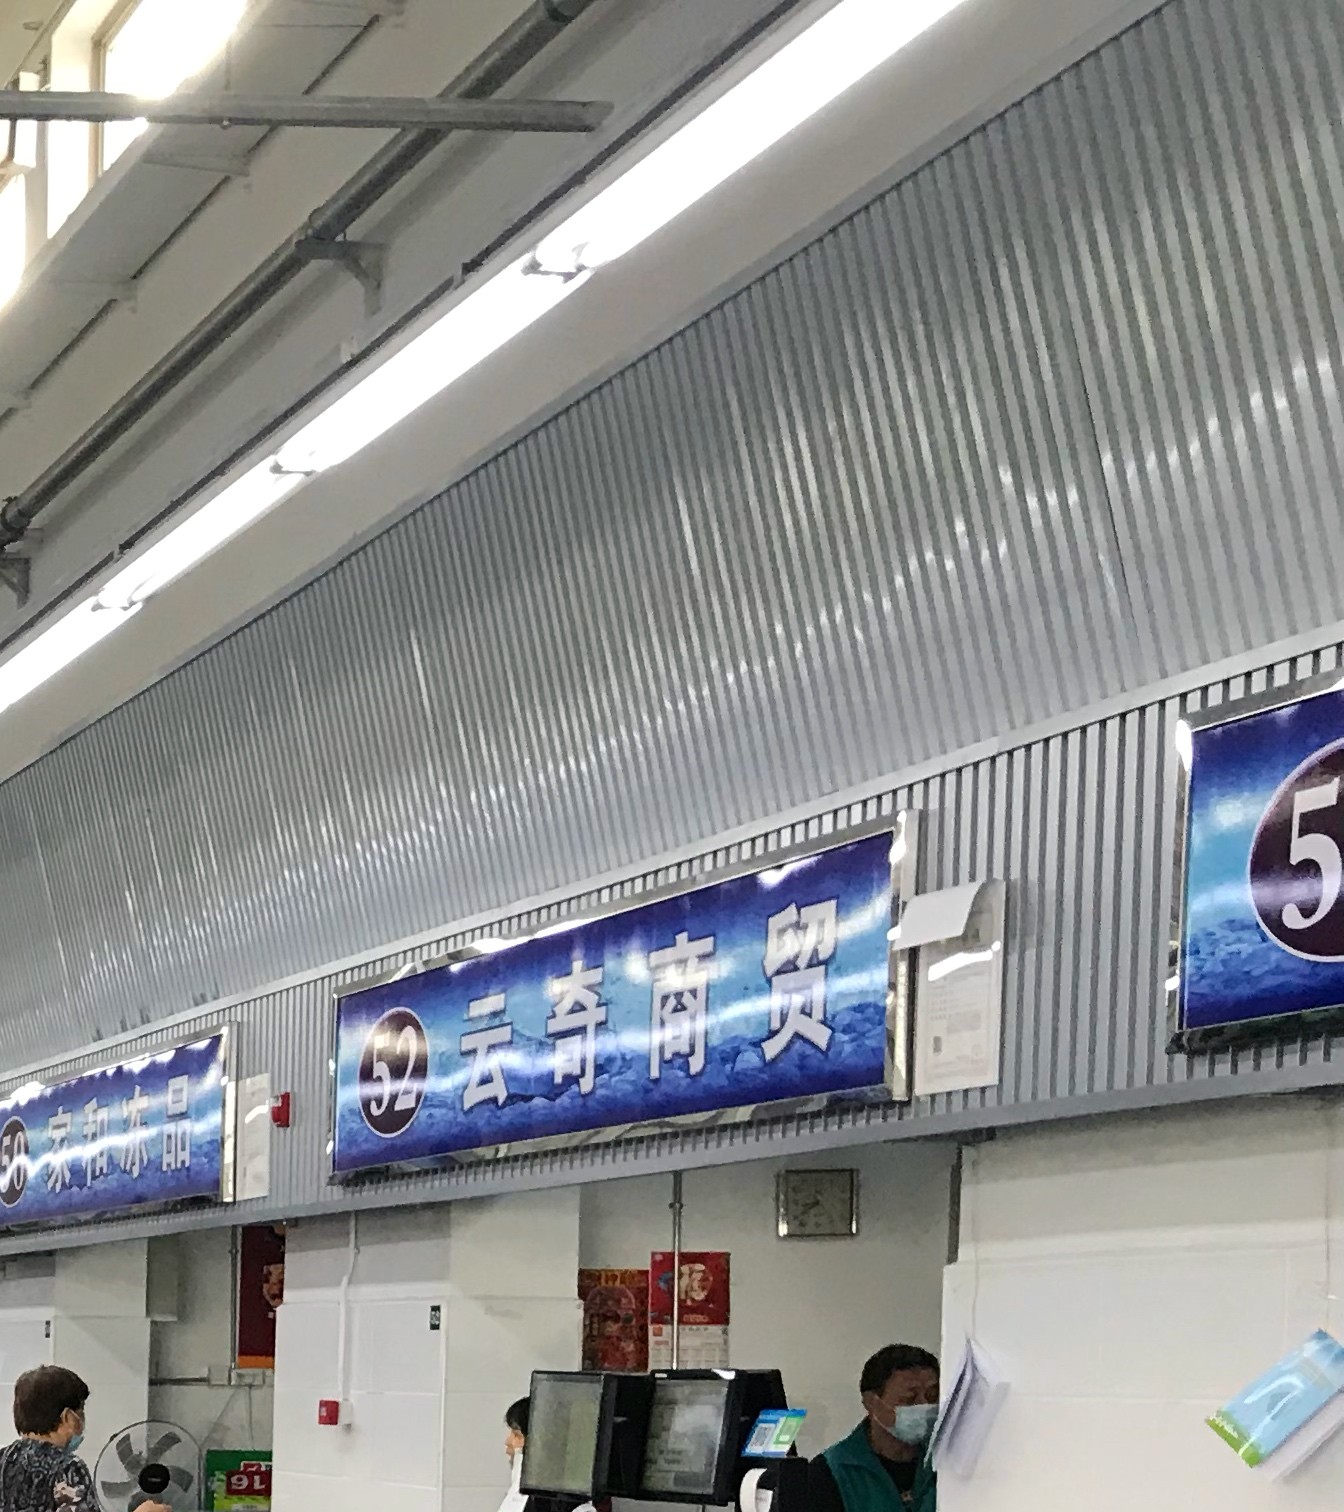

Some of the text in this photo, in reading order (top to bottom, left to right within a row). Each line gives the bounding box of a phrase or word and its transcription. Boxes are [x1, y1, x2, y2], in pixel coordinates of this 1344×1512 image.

[368, 1024, 421, 1116] 52
[460, 897, 839, 1113] 云奇商贸
